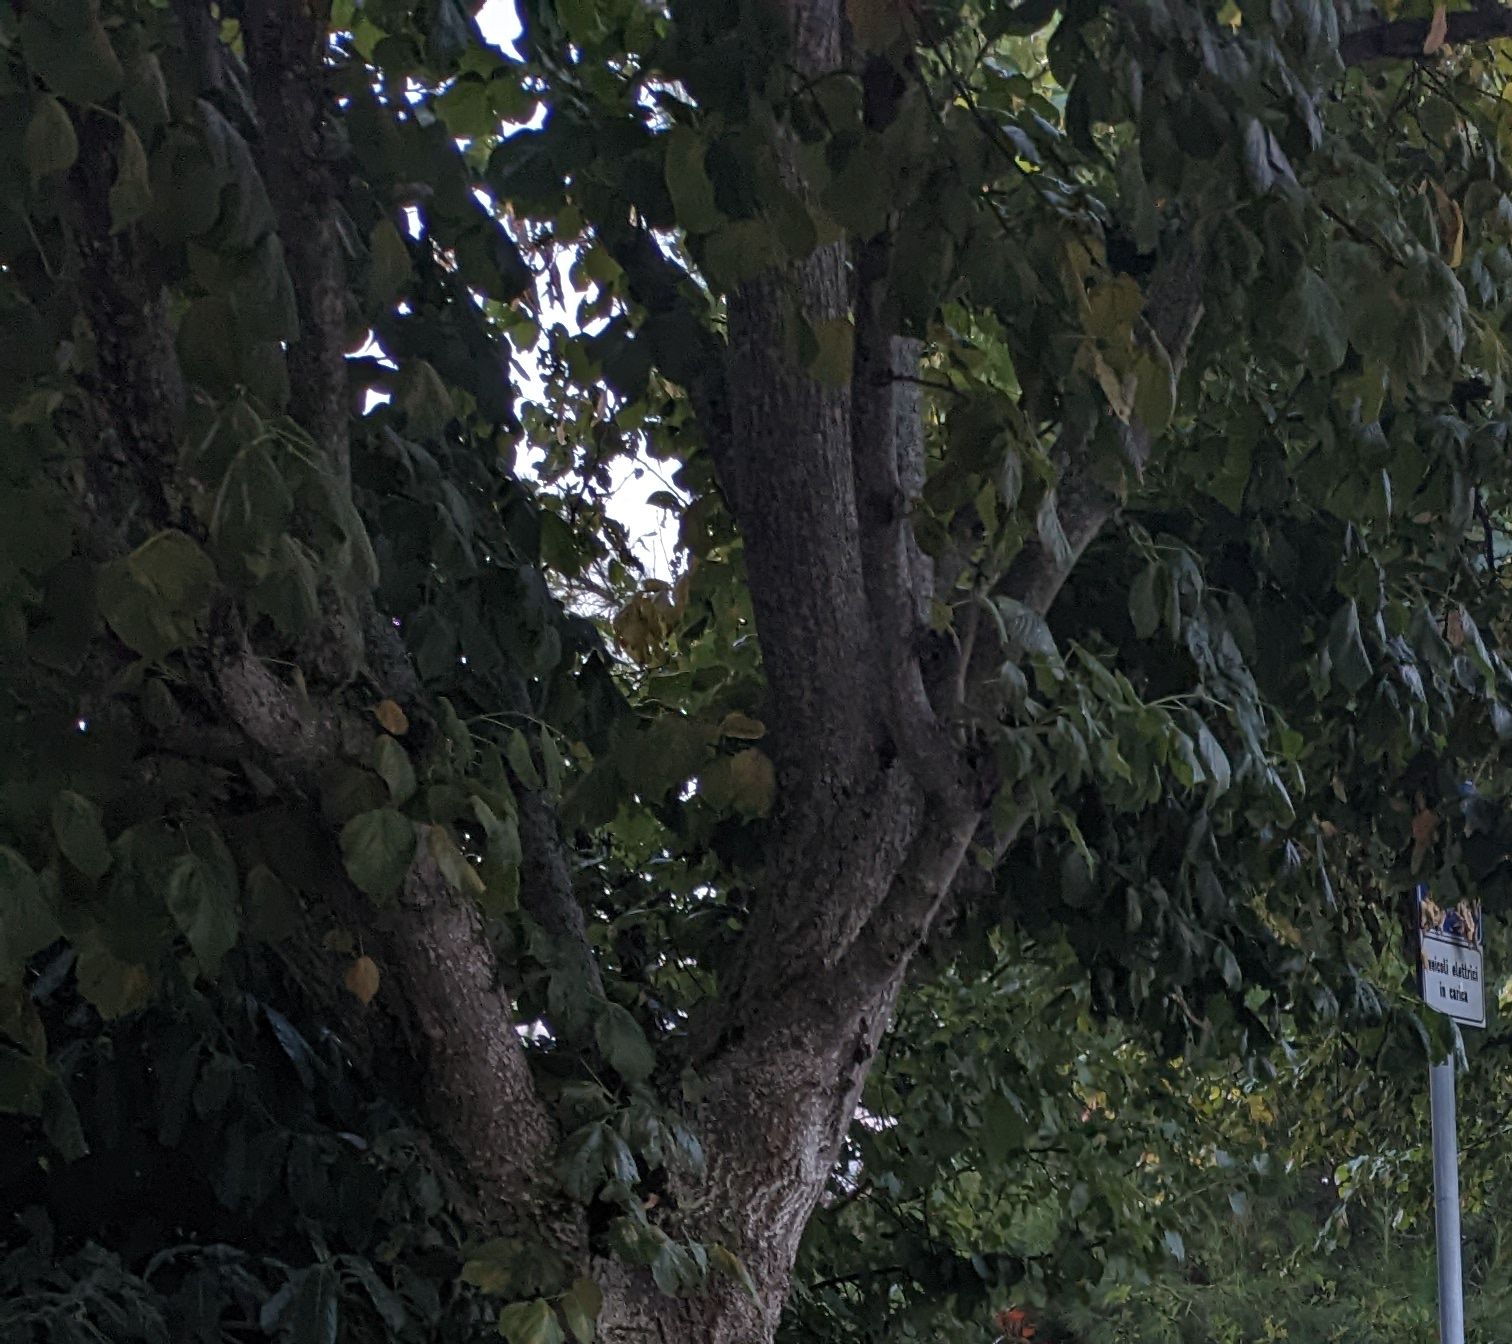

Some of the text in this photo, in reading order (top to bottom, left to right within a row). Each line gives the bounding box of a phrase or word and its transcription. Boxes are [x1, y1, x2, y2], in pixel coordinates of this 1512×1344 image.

[1428, 956, 1479, 982] veicoli elettrici
[1439, 981, 1468, 1003] in carica
